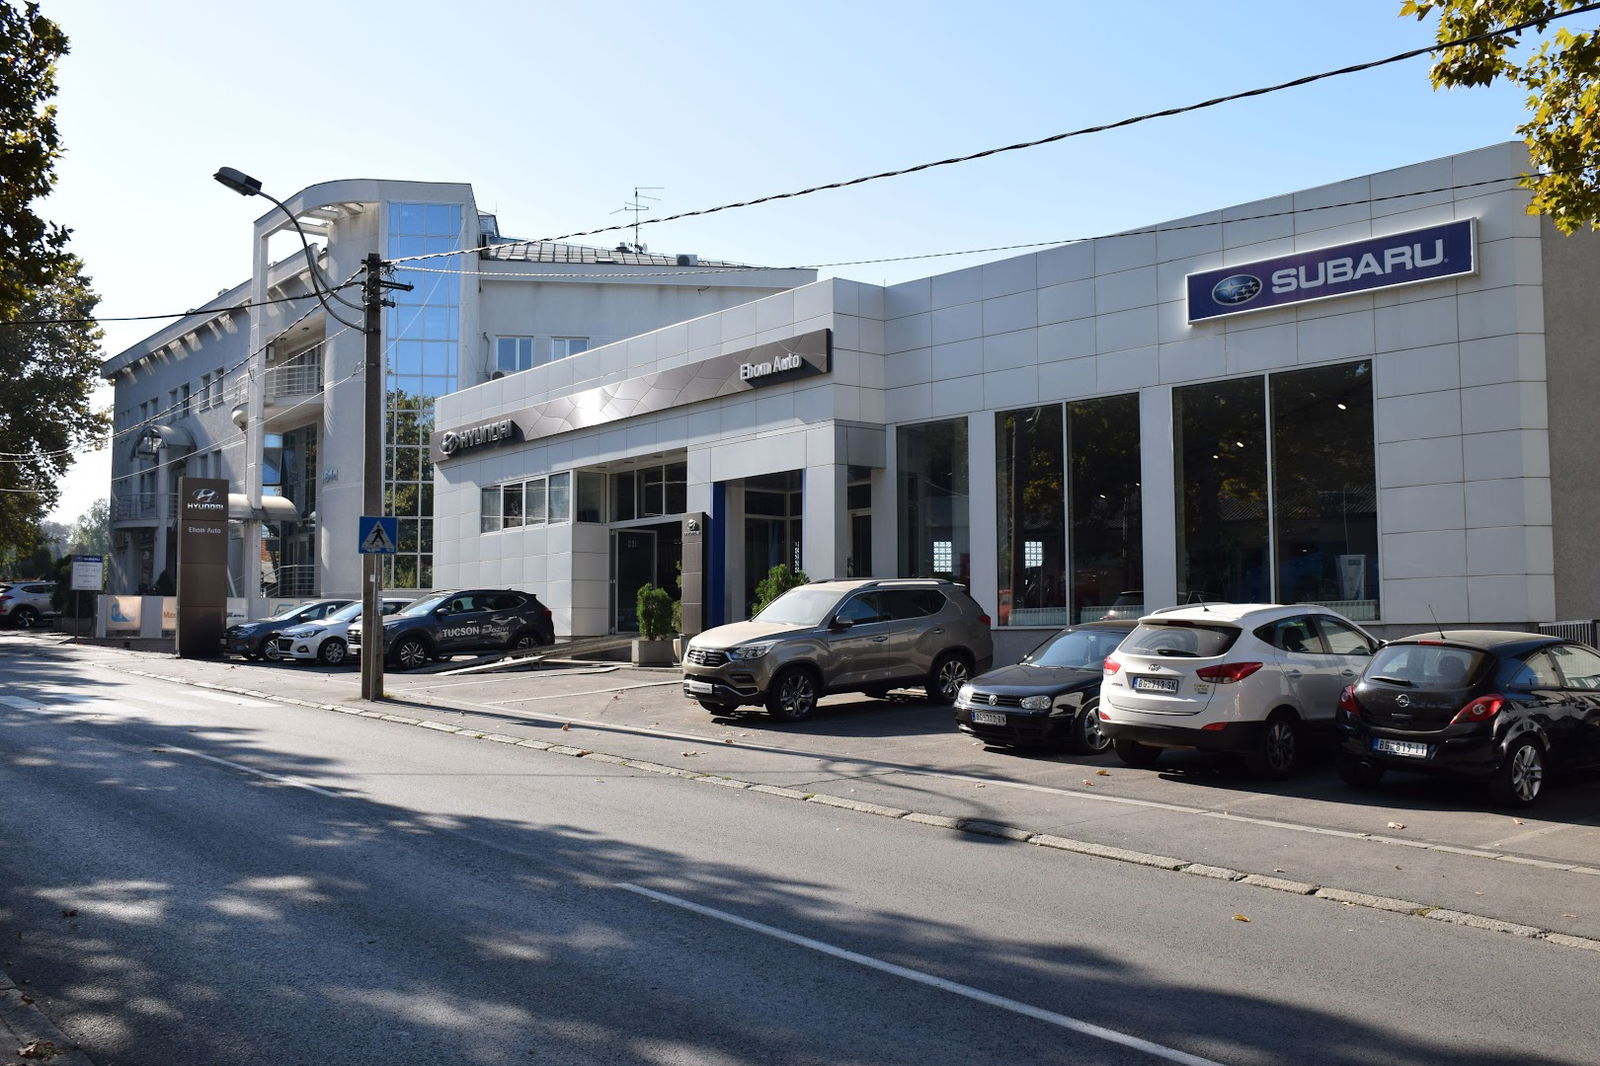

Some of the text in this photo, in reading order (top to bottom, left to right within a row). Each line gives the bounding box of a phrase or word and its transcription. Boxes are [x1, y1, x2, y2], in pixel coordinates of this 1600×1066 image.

[1272, 239, 1443, 294] SUBARU
[772, 352, 800, 373] Auto
[459, 418, 512, 448] HYUNDAI
[442, 626, 480, 638] TUCSON
